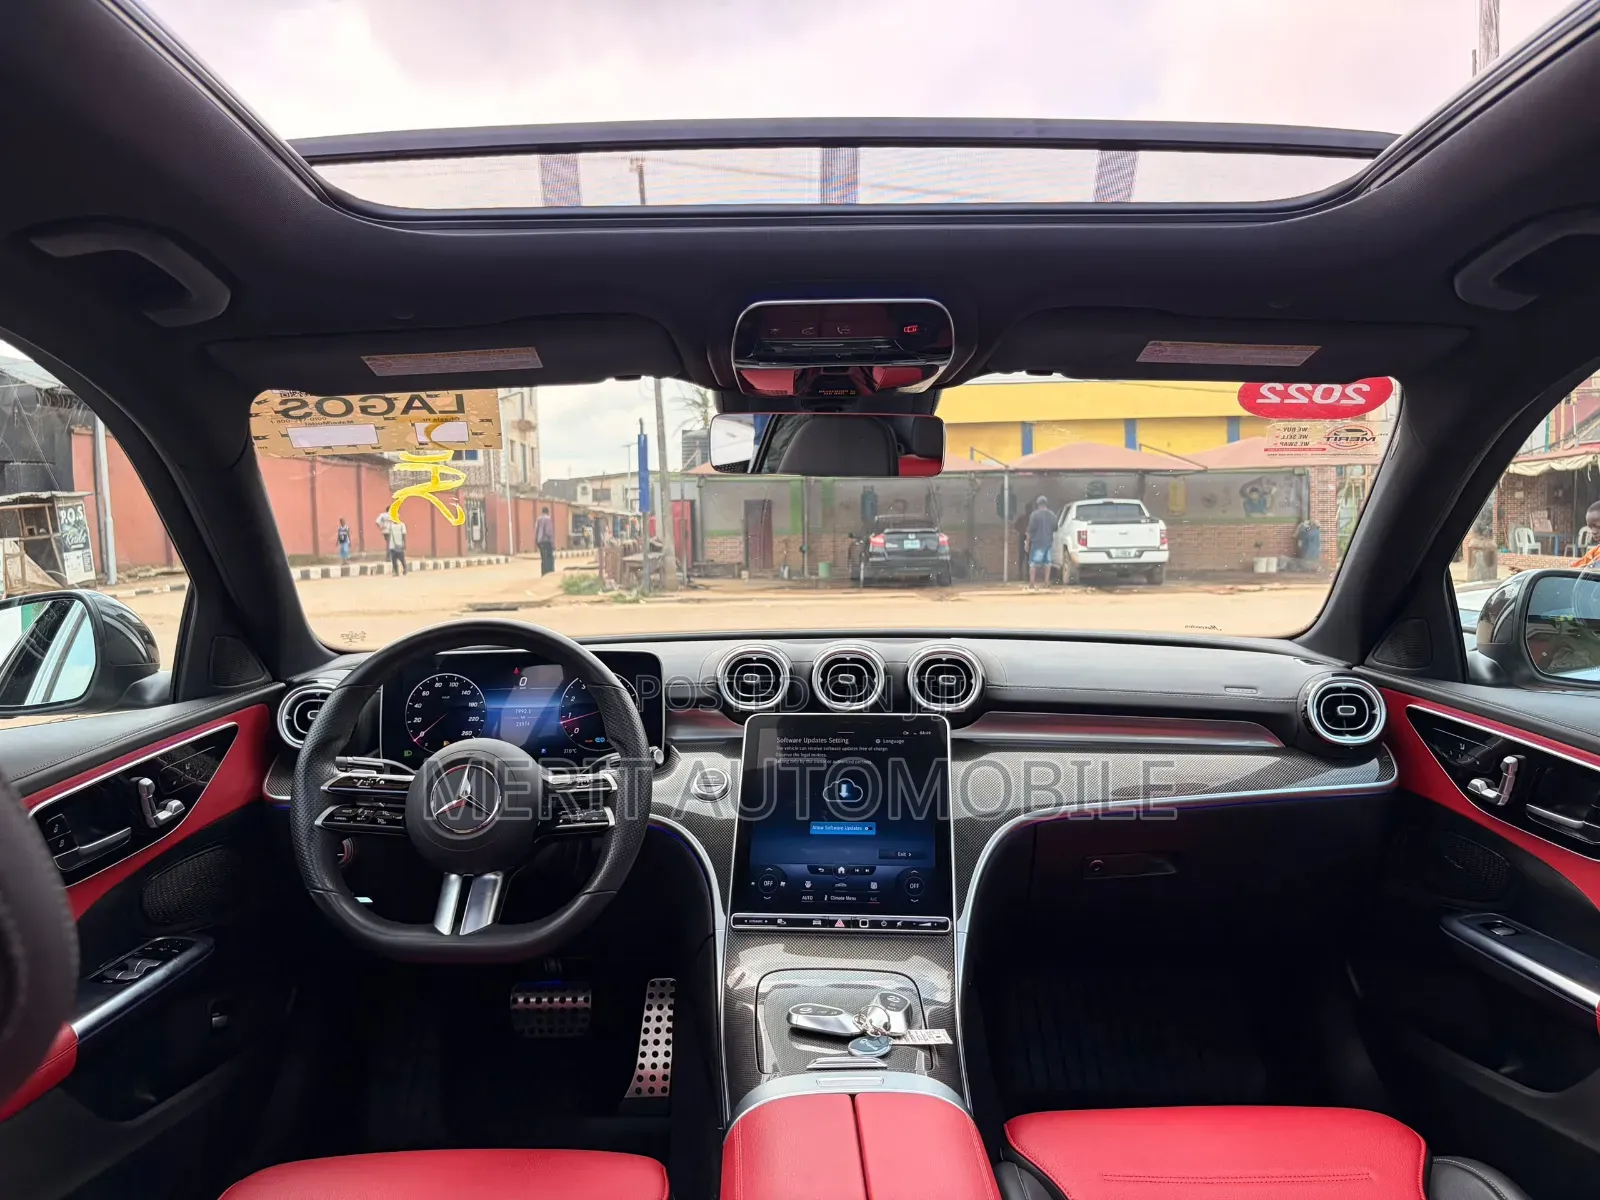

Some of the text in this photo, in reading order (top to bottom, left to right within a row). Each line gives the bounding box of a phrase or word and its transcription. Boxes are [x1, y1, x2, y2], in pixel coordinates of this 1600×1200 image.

[519, 676, 528, 686] 0
[776, 736, 802, 744] Software
[828, 737, 850, 745] Setting
